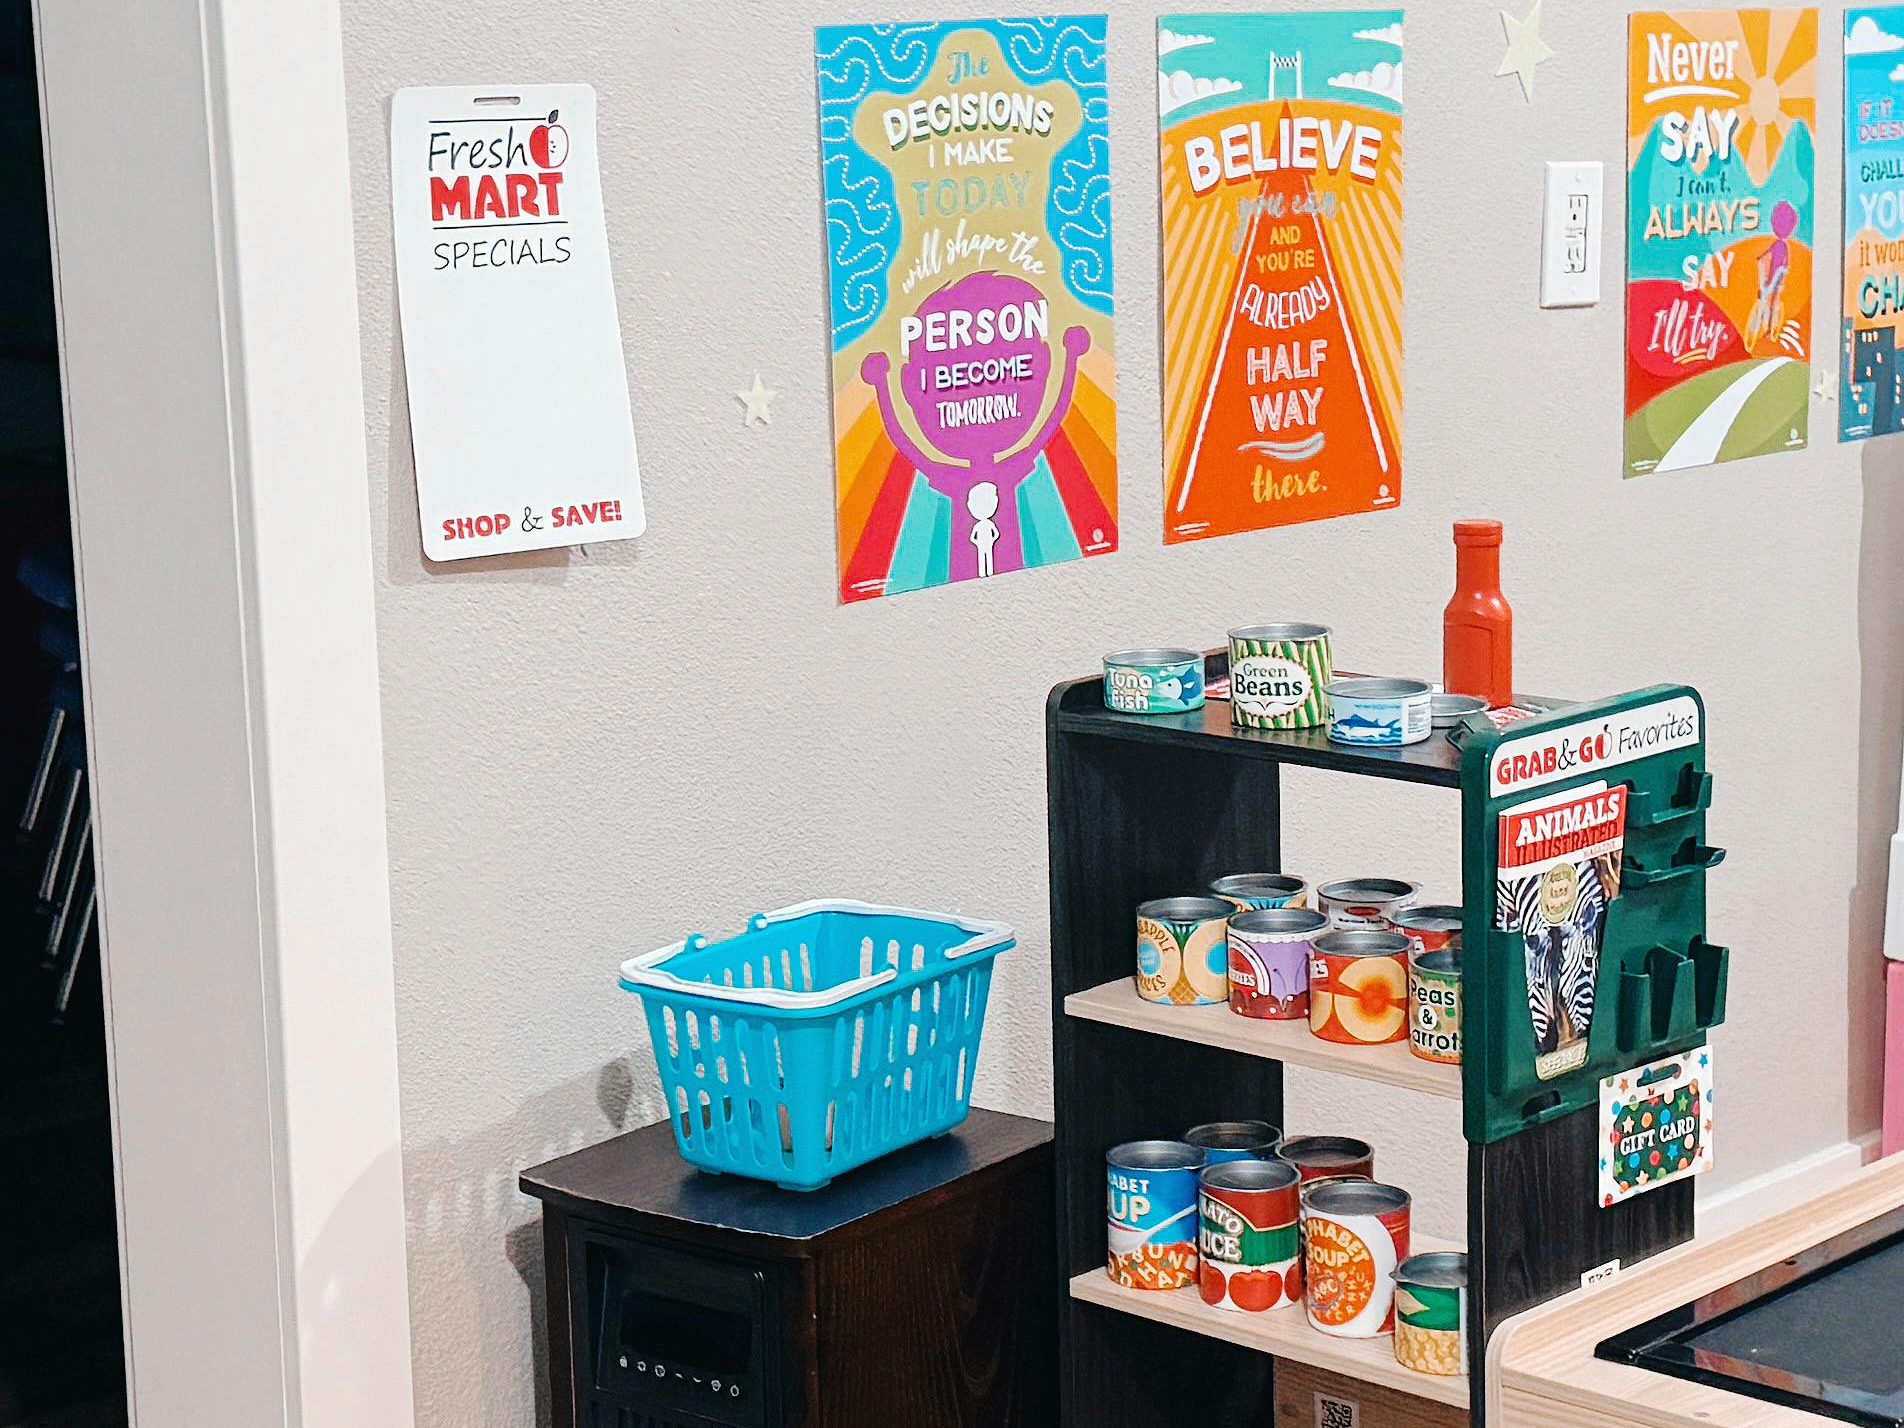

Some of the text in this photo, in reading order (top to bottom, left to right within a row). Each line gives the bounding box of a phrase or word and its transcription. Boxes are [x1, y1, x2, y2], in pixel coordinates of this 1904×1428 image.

[946, 49, 991, 85] The
[1646, 33, 1739, 86] Never
[882, 91, 1056, 150] DECISIONS
[1858, 98, 1894, 121] IF IT
[428, 126, 528, 172] Fresh
[927, 137, 1015, 168] I MAKE
[1183, 114, 1382, 194] BELIEVE
[1659, 106, 1739, 164] SAY
[430, 172, 564, 222] MART
[912, 171, 1034, 217] TODAY
[1269, 223, 1302, 246] AND
[1643, 197, 1761, 241] ALWAYS
[432, 235, 572, 271] SPECIALS
[900, 218, 1047, 296] will shape the
[1255, 247, 1316, 274] YOU'RE
[1680, 251, 1735, 292] SAY
[1858, 238, 1872, 268] it
[1239, 274, 1332, 330] ALREADY
[900, 297, 1050, 358] PERSON
[1647, 298, 1729, 361] I'll try.
[919, 354, 1035, 392] I BECOME
[1245, 339, 1329, 386] HALF
[935, 394, 1022, 430] TOMORROW.
[1248, 386, 1325, 434] WAY
[1249, 463, 1329, 504] there.
[442, 499, 623, 543] SHOP & SAVE!
[1109, 667, 1153, 690] Tuna
[1234, 672, 1304, 697] Beans
[1243, 662, 1289, 678] Green
[1618, 712, 1694, 754] Favorites
[1516, 793, 1621, 847] ANIMALS
[1422, 1009, 1432, 1025] &
[1412, 1029, 1460, 1051] arrot
[1620, 1116, 1696, 1156] GIFT CARD
